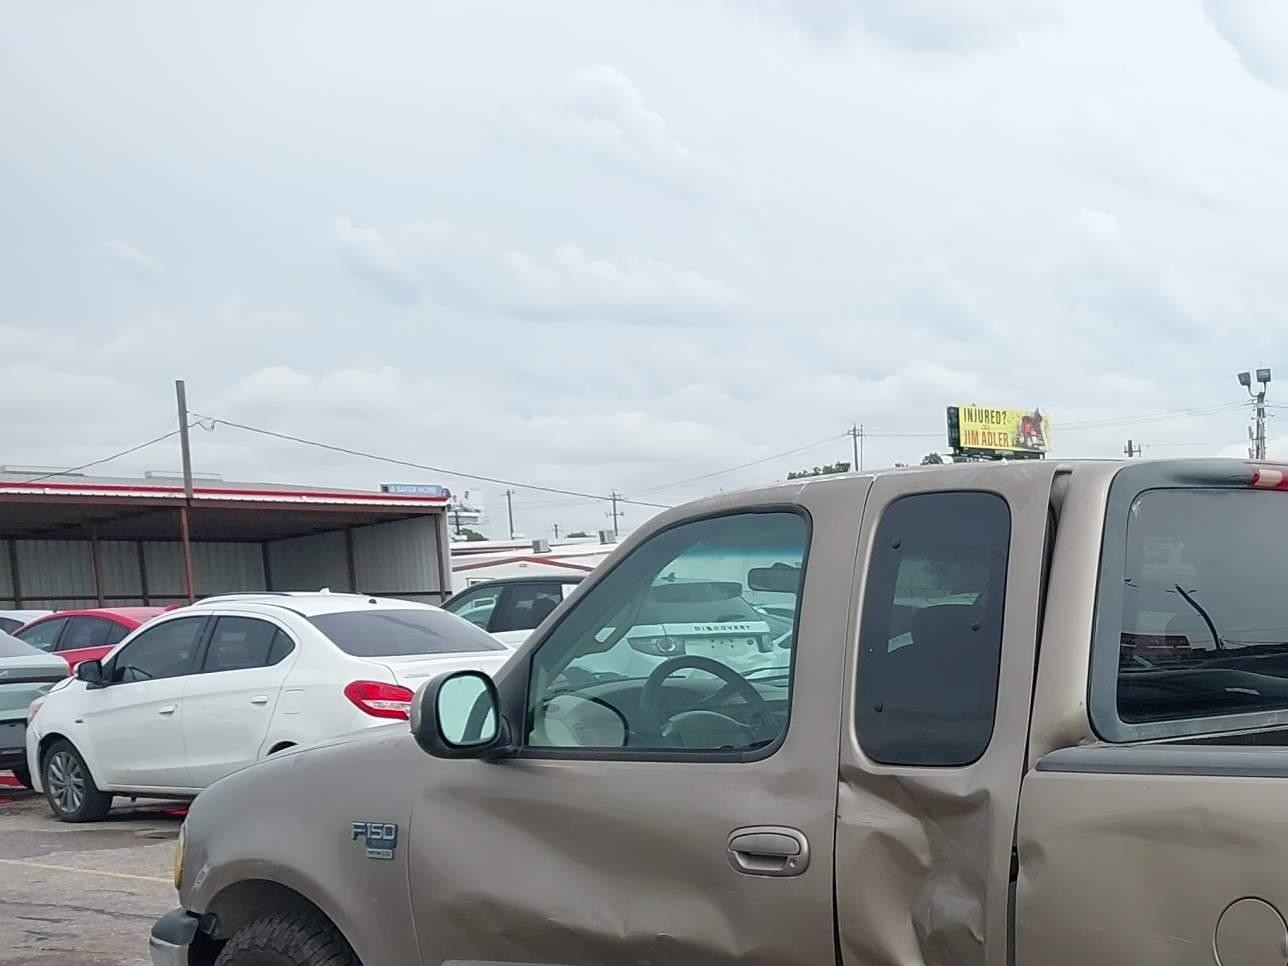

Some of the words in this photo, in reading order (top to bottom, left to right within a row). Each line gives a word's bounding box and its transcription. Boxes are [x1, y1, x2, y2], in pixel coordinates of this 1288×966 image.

[963, 407, 1007, 425] INJURED?
[964, 429, 979, 446] JIM
[981, 431, 1009, 448] ADLER
[693, 624, 751, 632] DISCOVERY
